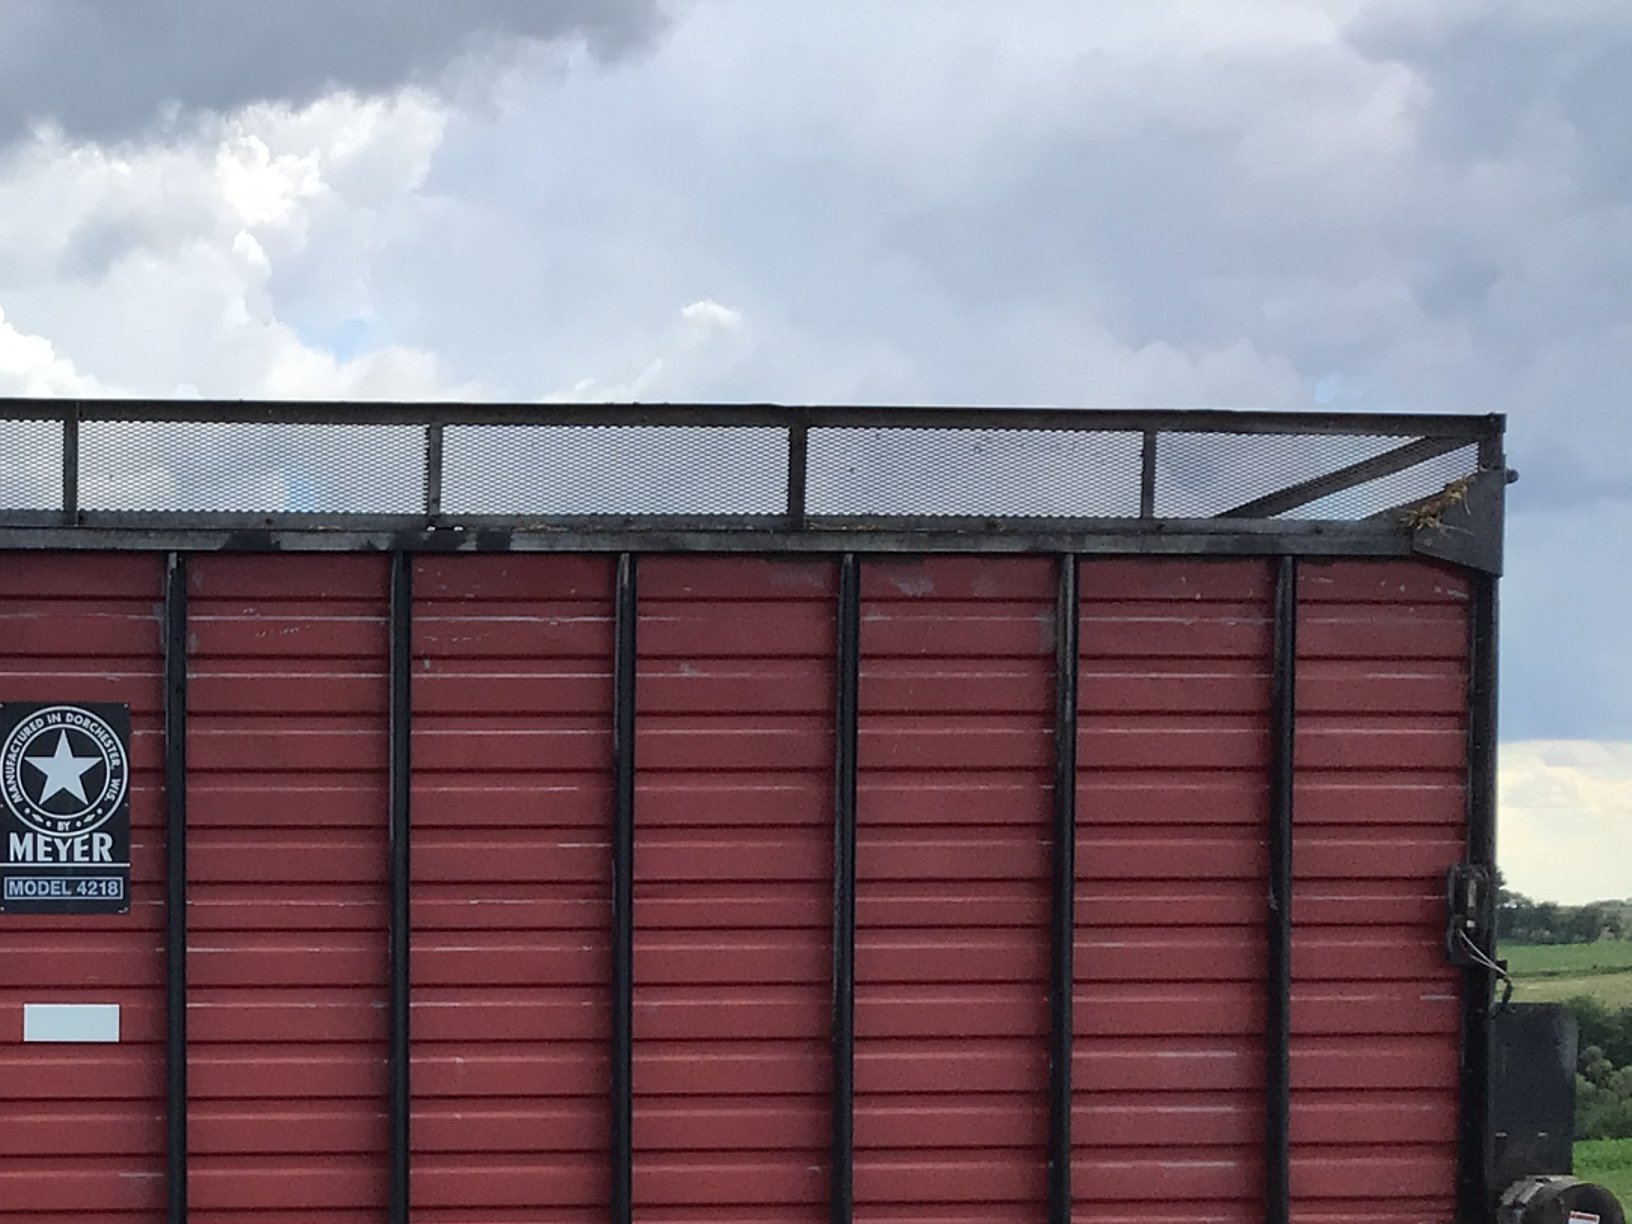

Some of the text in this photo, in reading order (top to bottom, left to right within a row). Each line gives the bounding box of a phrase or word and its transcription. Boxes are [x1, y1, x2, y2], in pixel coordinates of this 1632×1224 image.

[5, 718, 45, 804] MANUFACTURED
[46, 712, 62, 724] IN
[57, 821, 71, 831] BY
[9, 832, 113, 862] MEYER
[8, 881, 119, 896] MODEL 4218
